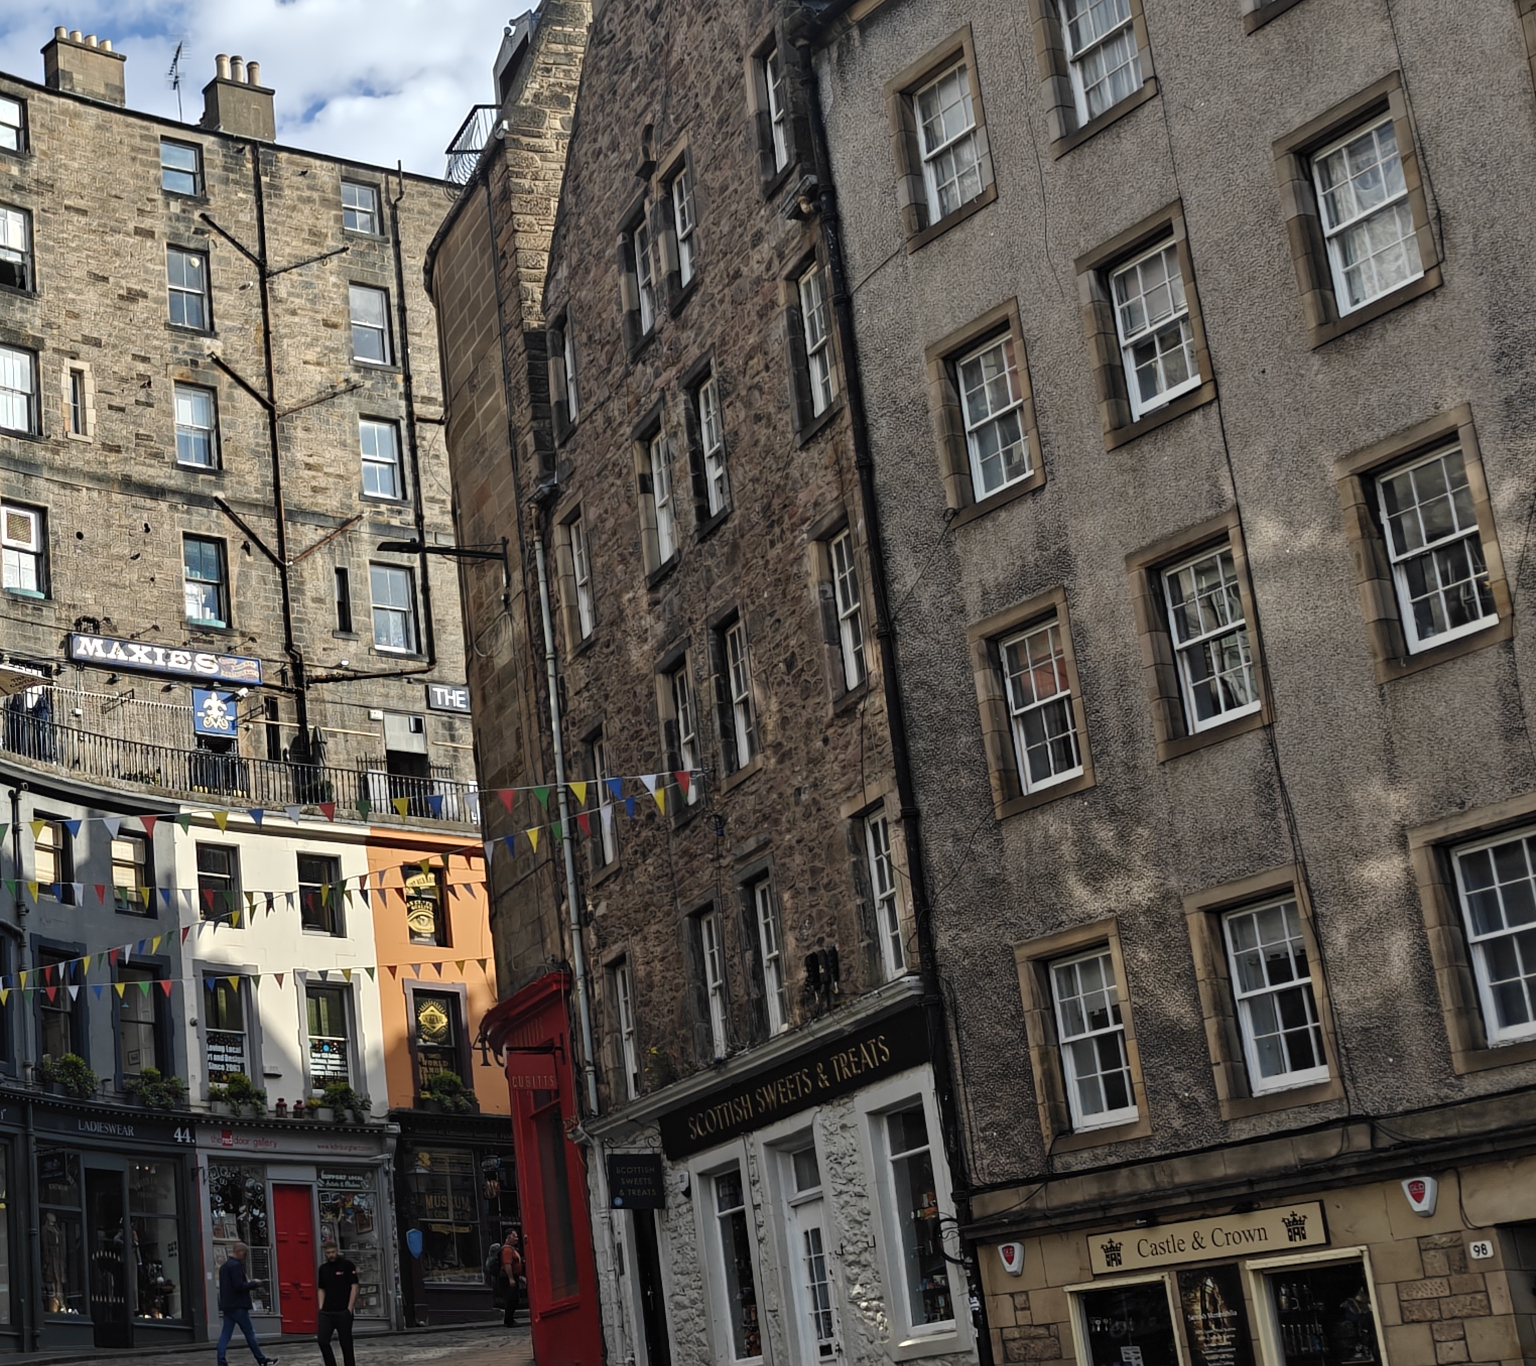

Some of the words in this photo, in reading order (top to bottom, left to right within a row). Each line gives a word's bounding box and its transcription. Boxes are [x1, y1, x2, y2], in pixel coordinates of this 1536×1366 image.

[77, 636, 219, 674] MAXIES
[432, 687, 467, 708] THE
[512, 1075, 555, 1088] CUBITTS
[687, 1092, 754, 1141] SCOTTISH
[755, 1067, 813, 1114] SWEETS
[816, 1061, 830, 1089] &
[830, 1035, 891, 1083] TREATS
[77, 1119, 135, 1137] LADIESWEAR
[233, 1136, 250, 1144] door
[253, 1136, 278, 1149] gallery
[615, 1166, 655, 1174] SCOTTISH
[620, 1177, 653, 1185] SWEETS
[627, 1188, 656, 1196] TREATS
[425, 1194, 471, 1212] MUSUM
[1136, 1233, 1186, 1258] Castle
[1190, 1230, 1207, 1251] &
[1211, 1225, 1269, 1248] Crown
[1472, 1243, 1488, 1256] 98
